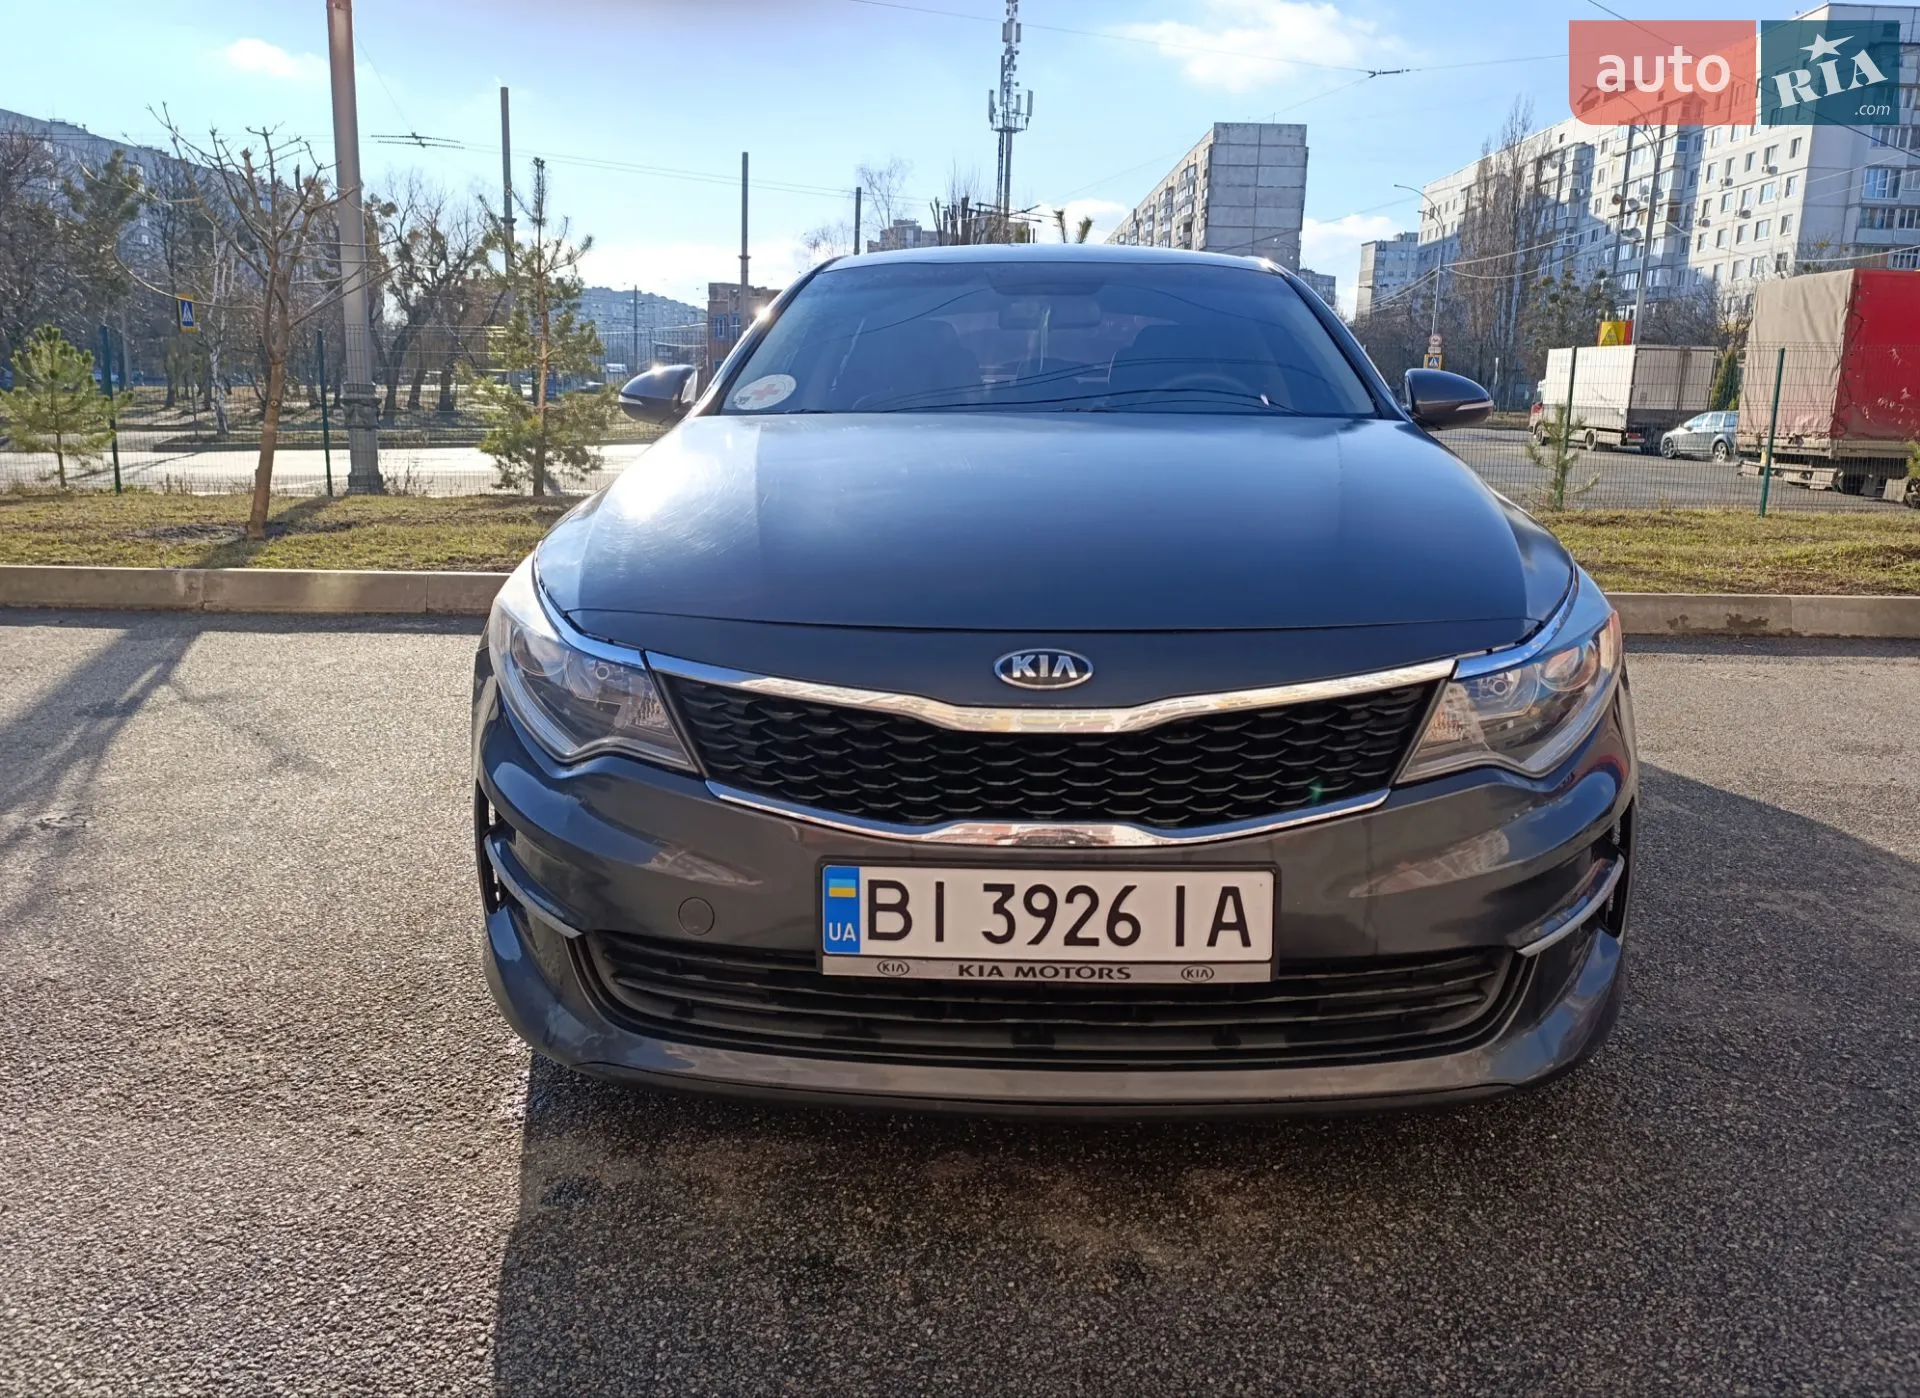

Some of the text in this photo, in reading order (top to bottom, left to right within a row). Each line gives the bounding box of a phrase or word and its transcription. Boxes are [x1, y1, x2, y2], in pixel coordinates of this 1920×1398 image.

[1011, 654, 1078, 679] KIA
[867, 879, 1252, 948] BI 3926 IA
[828, 922, 857, 942] UA
[882, 963, 904, 973] KIA
[958, 964, 1132, 980] KIA MOTORS
[1186, 969, 1210, 979] KIA
